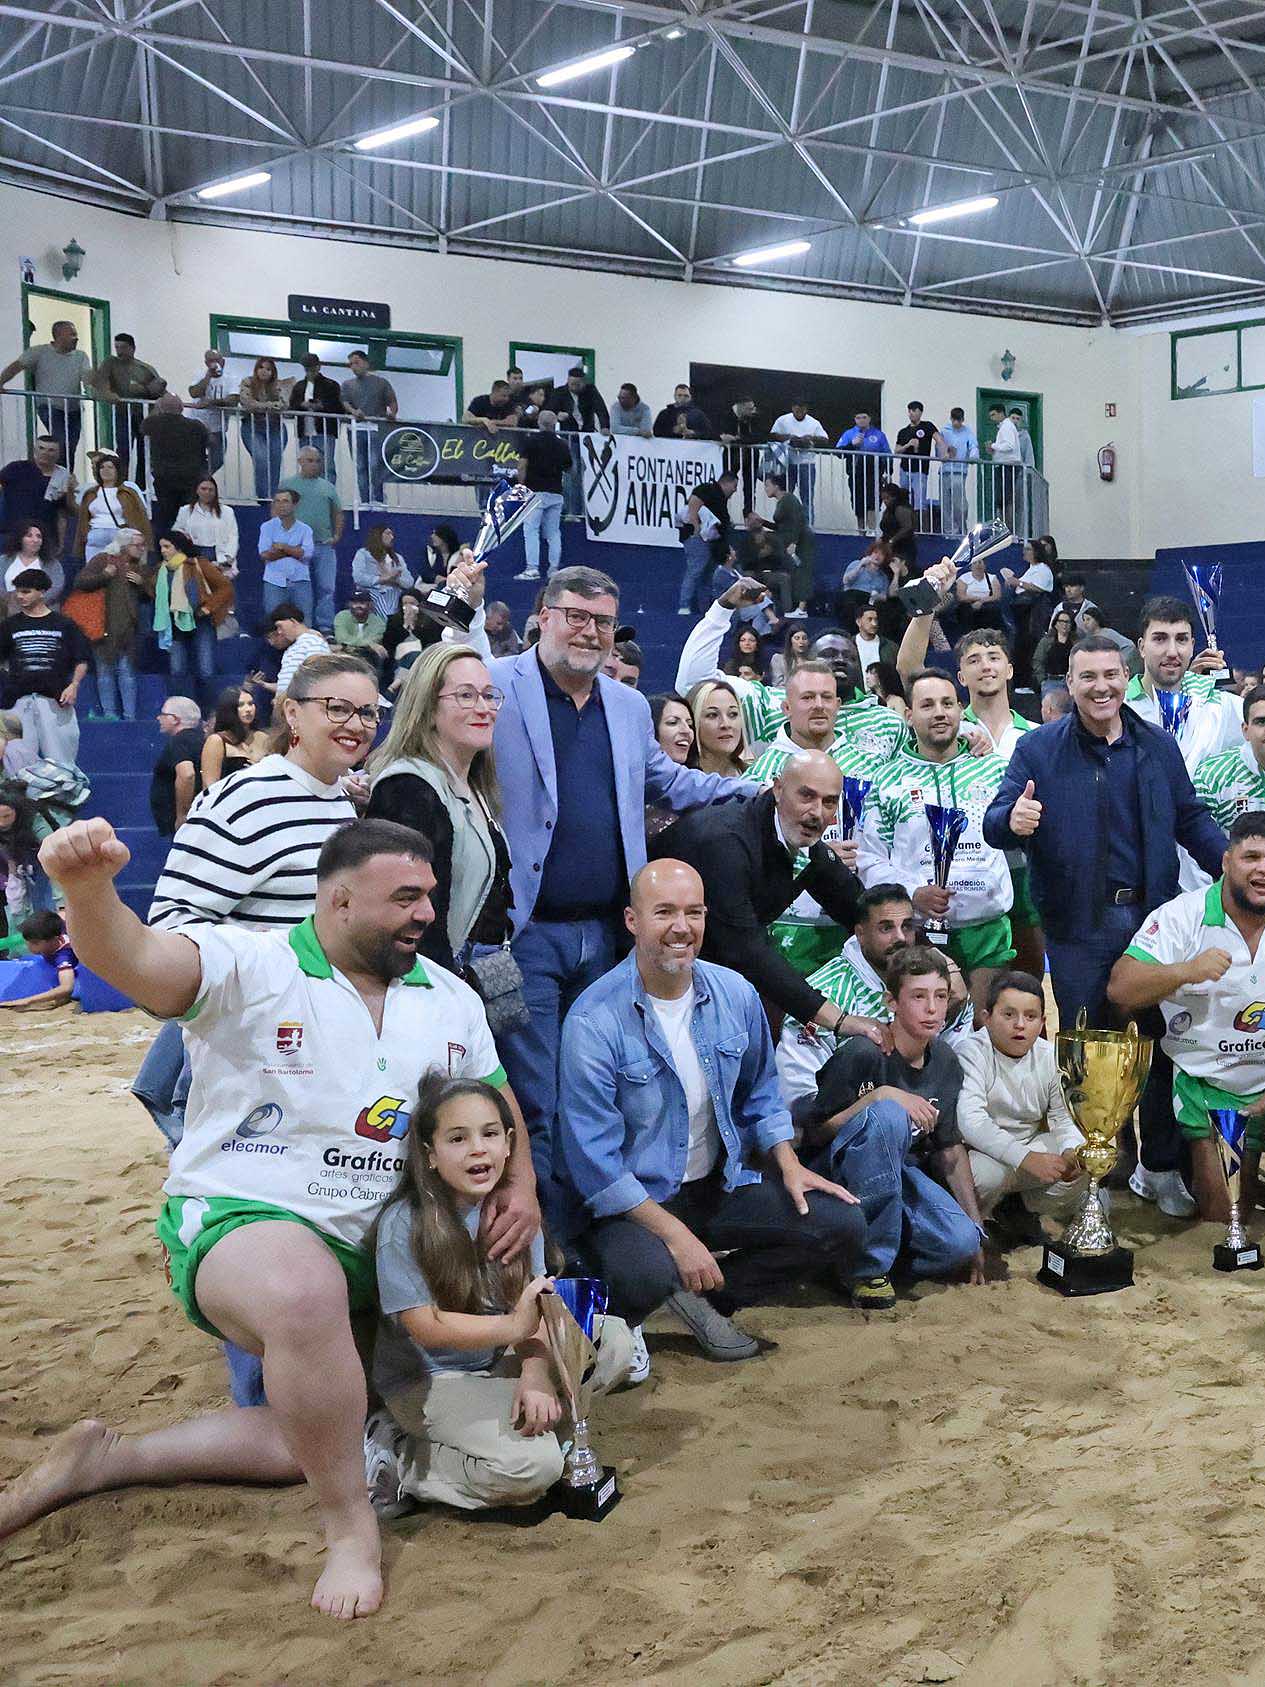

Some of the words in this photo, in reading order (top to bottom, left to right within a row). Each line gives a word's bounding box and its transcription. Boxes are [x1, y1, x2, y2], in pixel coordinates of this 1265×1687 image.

[302, 304, 317, 313] LA
[322, 306, 376, 319] CANTINA
[441, 438, 464, 460] El
[627, 455, 717, 486] FONTANERIA
[624, 481, 689, 529] AMAD
[221, 1139, 288, 1155] elecmor
[323, 1147, 403, 1172] Grafica
[319, 1168, 348, 1180] artes
[307, 1181, 348, 1200] Grupo
[350, 1186, 392, 1201] Cabrer
